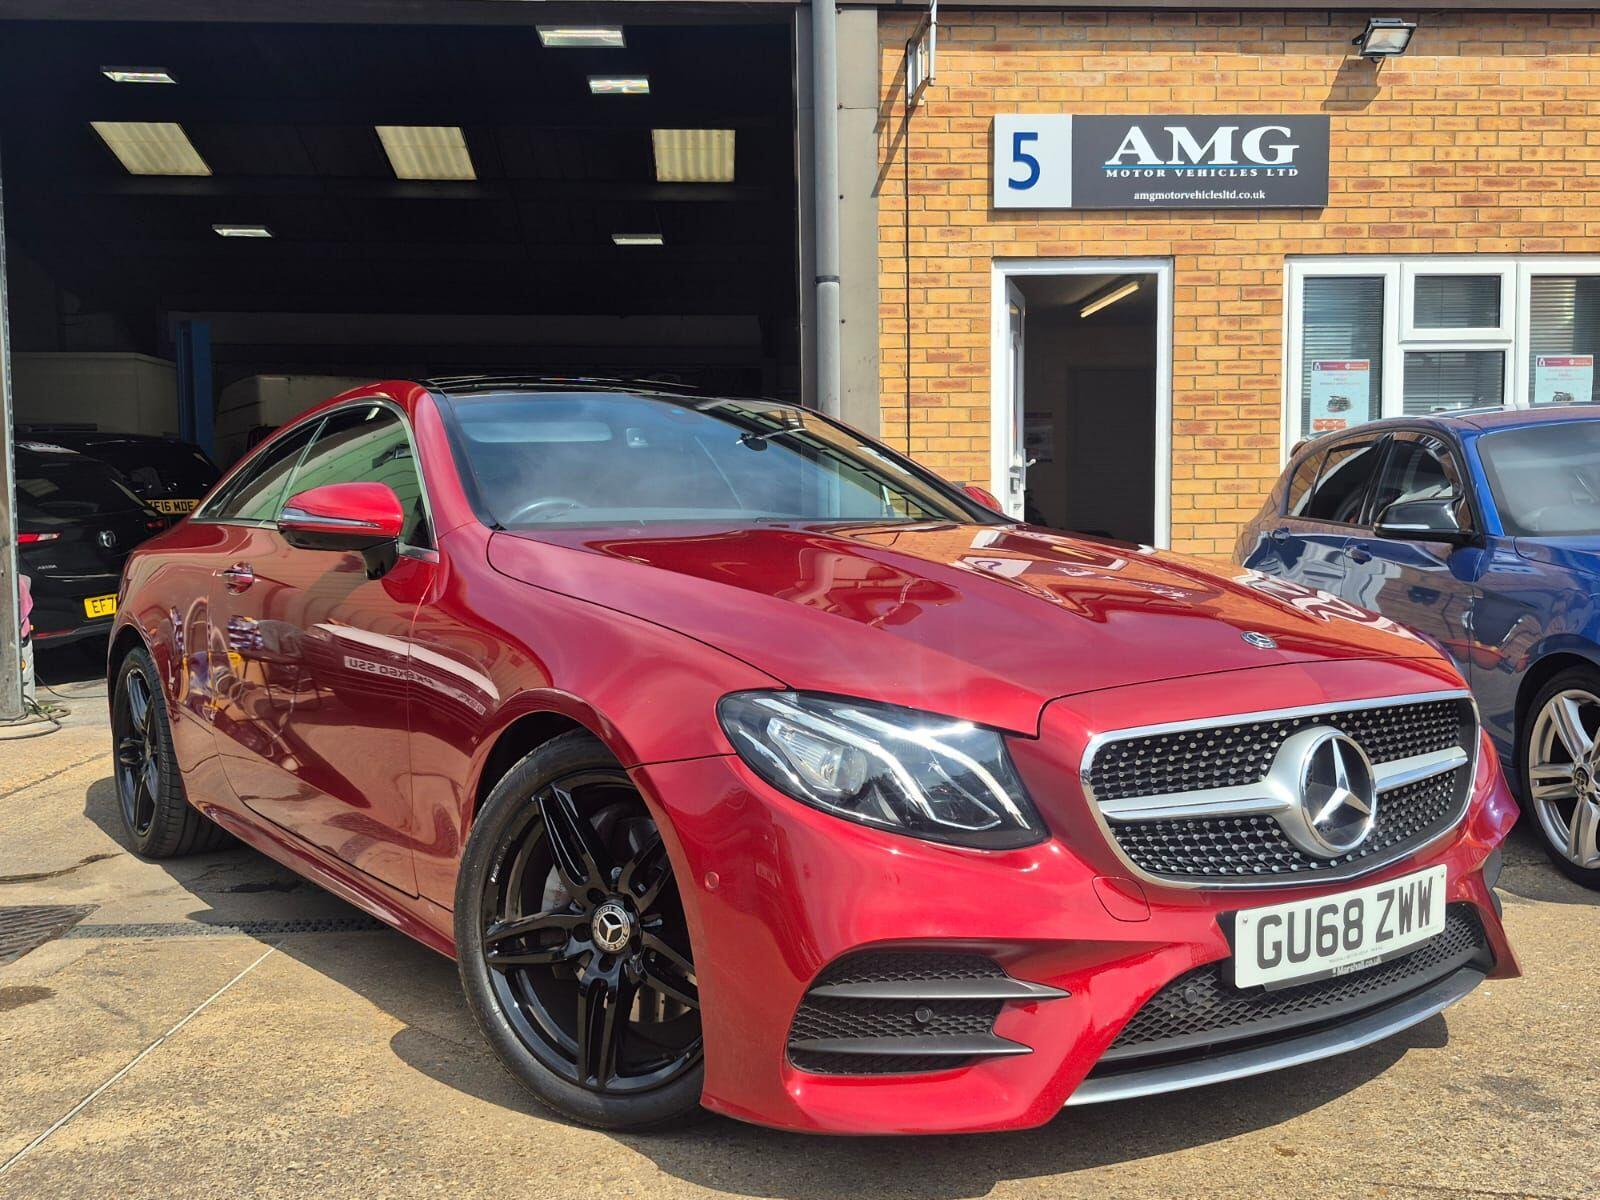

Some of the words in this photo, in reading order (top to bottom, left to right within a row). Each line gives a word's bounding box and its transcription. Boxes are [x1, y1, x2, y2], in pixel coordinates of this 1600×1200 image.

[1105, 125, 1300, 166] AMG
[1008, 131, 1041, 191] 5
[1106, 169, 1166, 178] MOTOR
[1175, 169, 1258, 177] VEHICLES
[1267, 168, 1299, 177] LTD
[1134, 189, 1266, 202] amgmotorvehiclesltd.co.uk
[173, 500, 194, 512] MDE
[91, 597, 114, 614] EF7
[1256, 897, 1364, 970] GU68
[1375, 876, 1433, 943] ZWW
